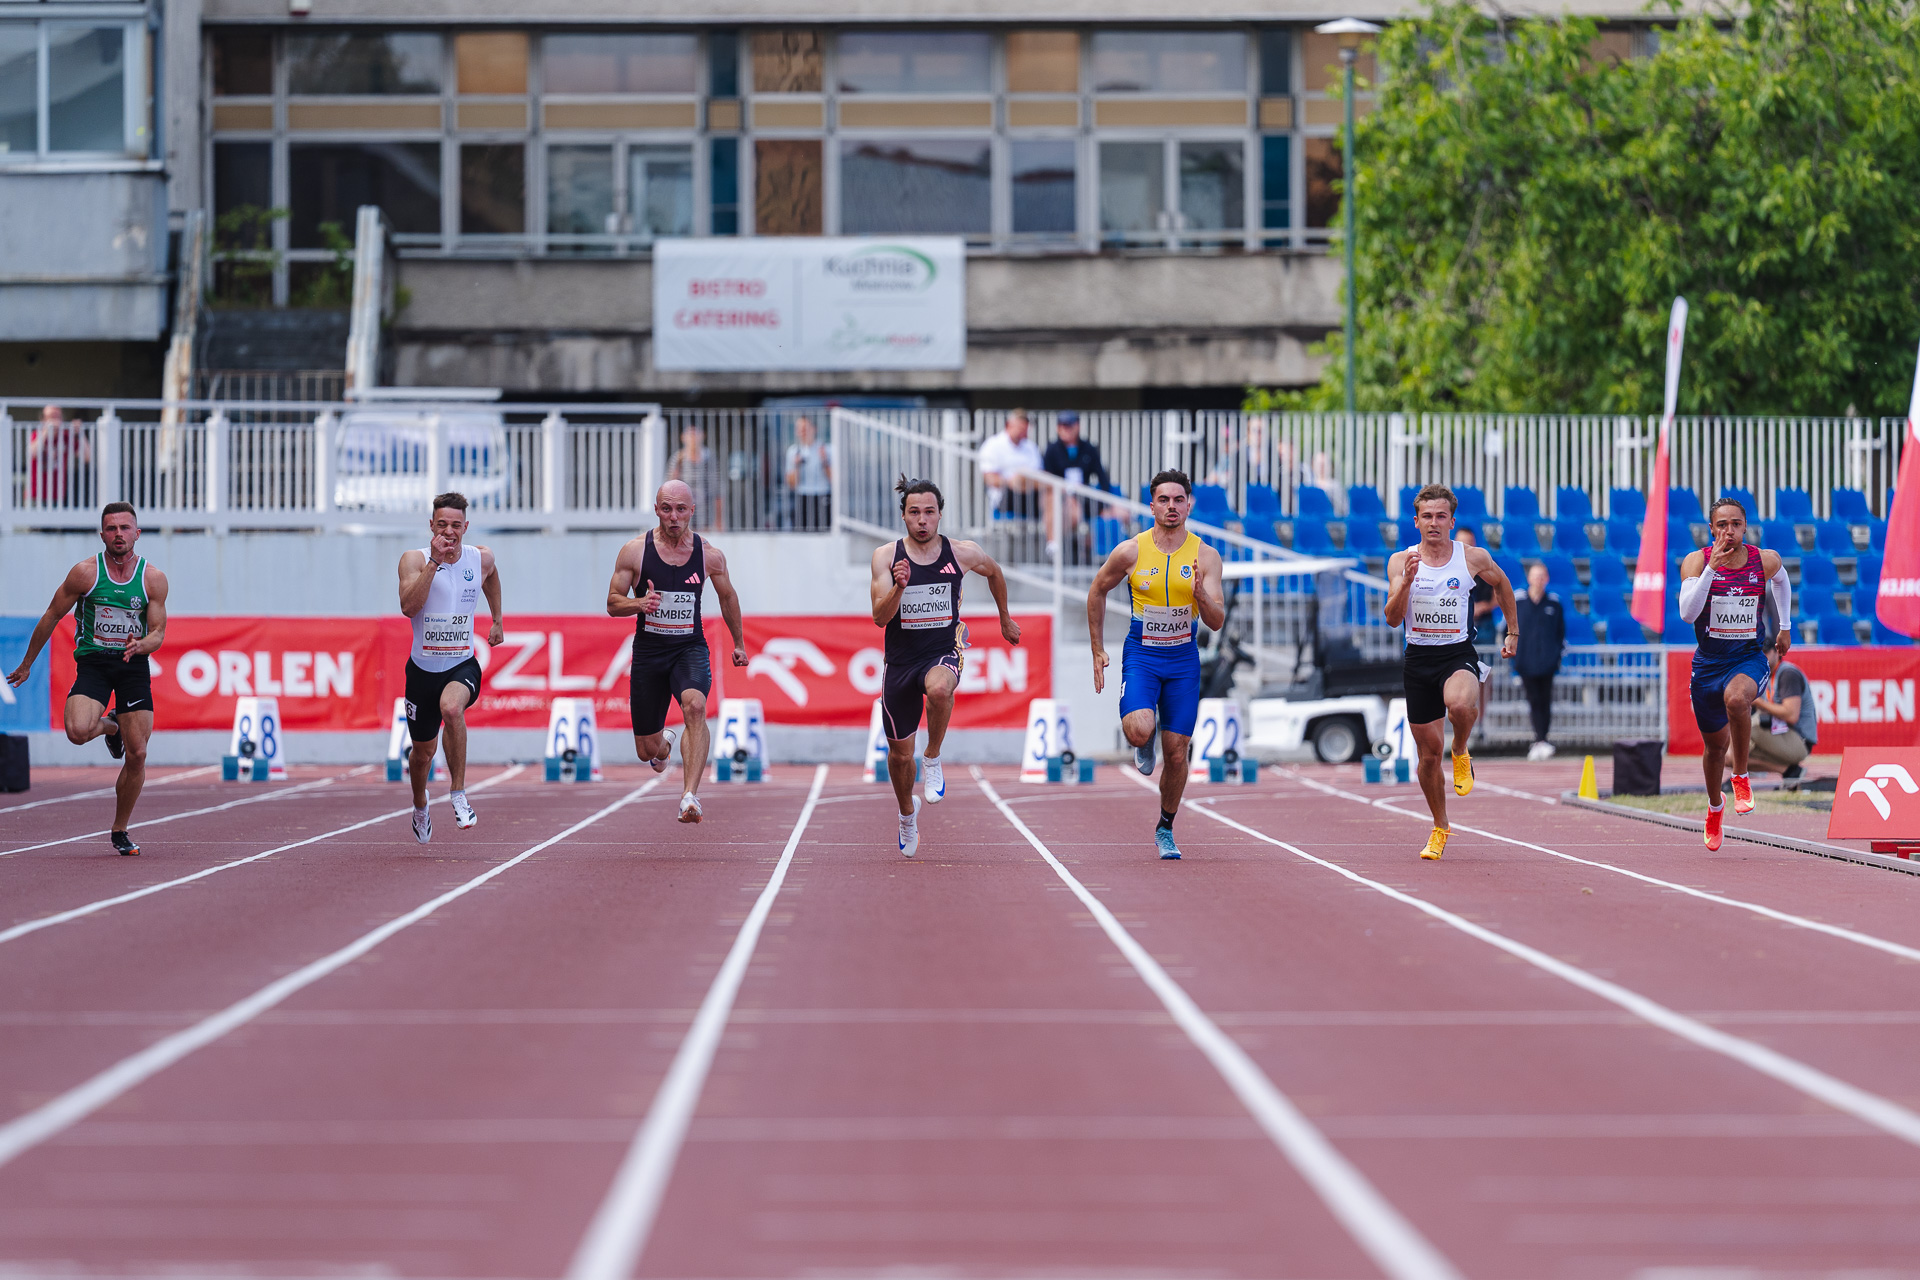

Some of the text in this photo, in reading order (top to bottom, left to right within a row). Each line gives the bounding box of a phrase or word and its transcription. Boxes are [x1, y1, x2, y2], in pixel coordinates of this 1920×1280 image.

[688, 279, 766, 298] BISTRO
[674, 309, 780, 329] CATERING
[674, 594, 691, 603] 252
[928, 586, 947, 595] 367
[902, 600, 950, 614] BOGACZYŃSKI
[1172, 607, 1188, 616] 356
[1440, 598, 1457, 607] 366
[1738, 598, 1755, 607] 422
[452, 615, 468, 624] 287
[1146, 621, 1188, 633] GRZĄKA
[1415, 612, 1458, 623] WRÓBEL
[1716, 613, 1753, 624] YAMAH
[96, 622, 141, 633] KOZELAN
[425, 631, 469, 641] OPUSZEWICZ
[176, 649, 354, 697] ORLEN
[849, 647, 1028, 694] OEN
[1809, 679, 1915, 724] RLEN
[261, 715, 276, 758] 8
[554, 717, 569, 758] 6
[577, 717, 593, 757] 6
[724, 718, 738, 759] 5
[748, 718, 762, 758] 5
[1032, 718, 1047, 761] 3
[1202, 717, 1218, 760] 2
[1393, 717, 1405, 759] 1
